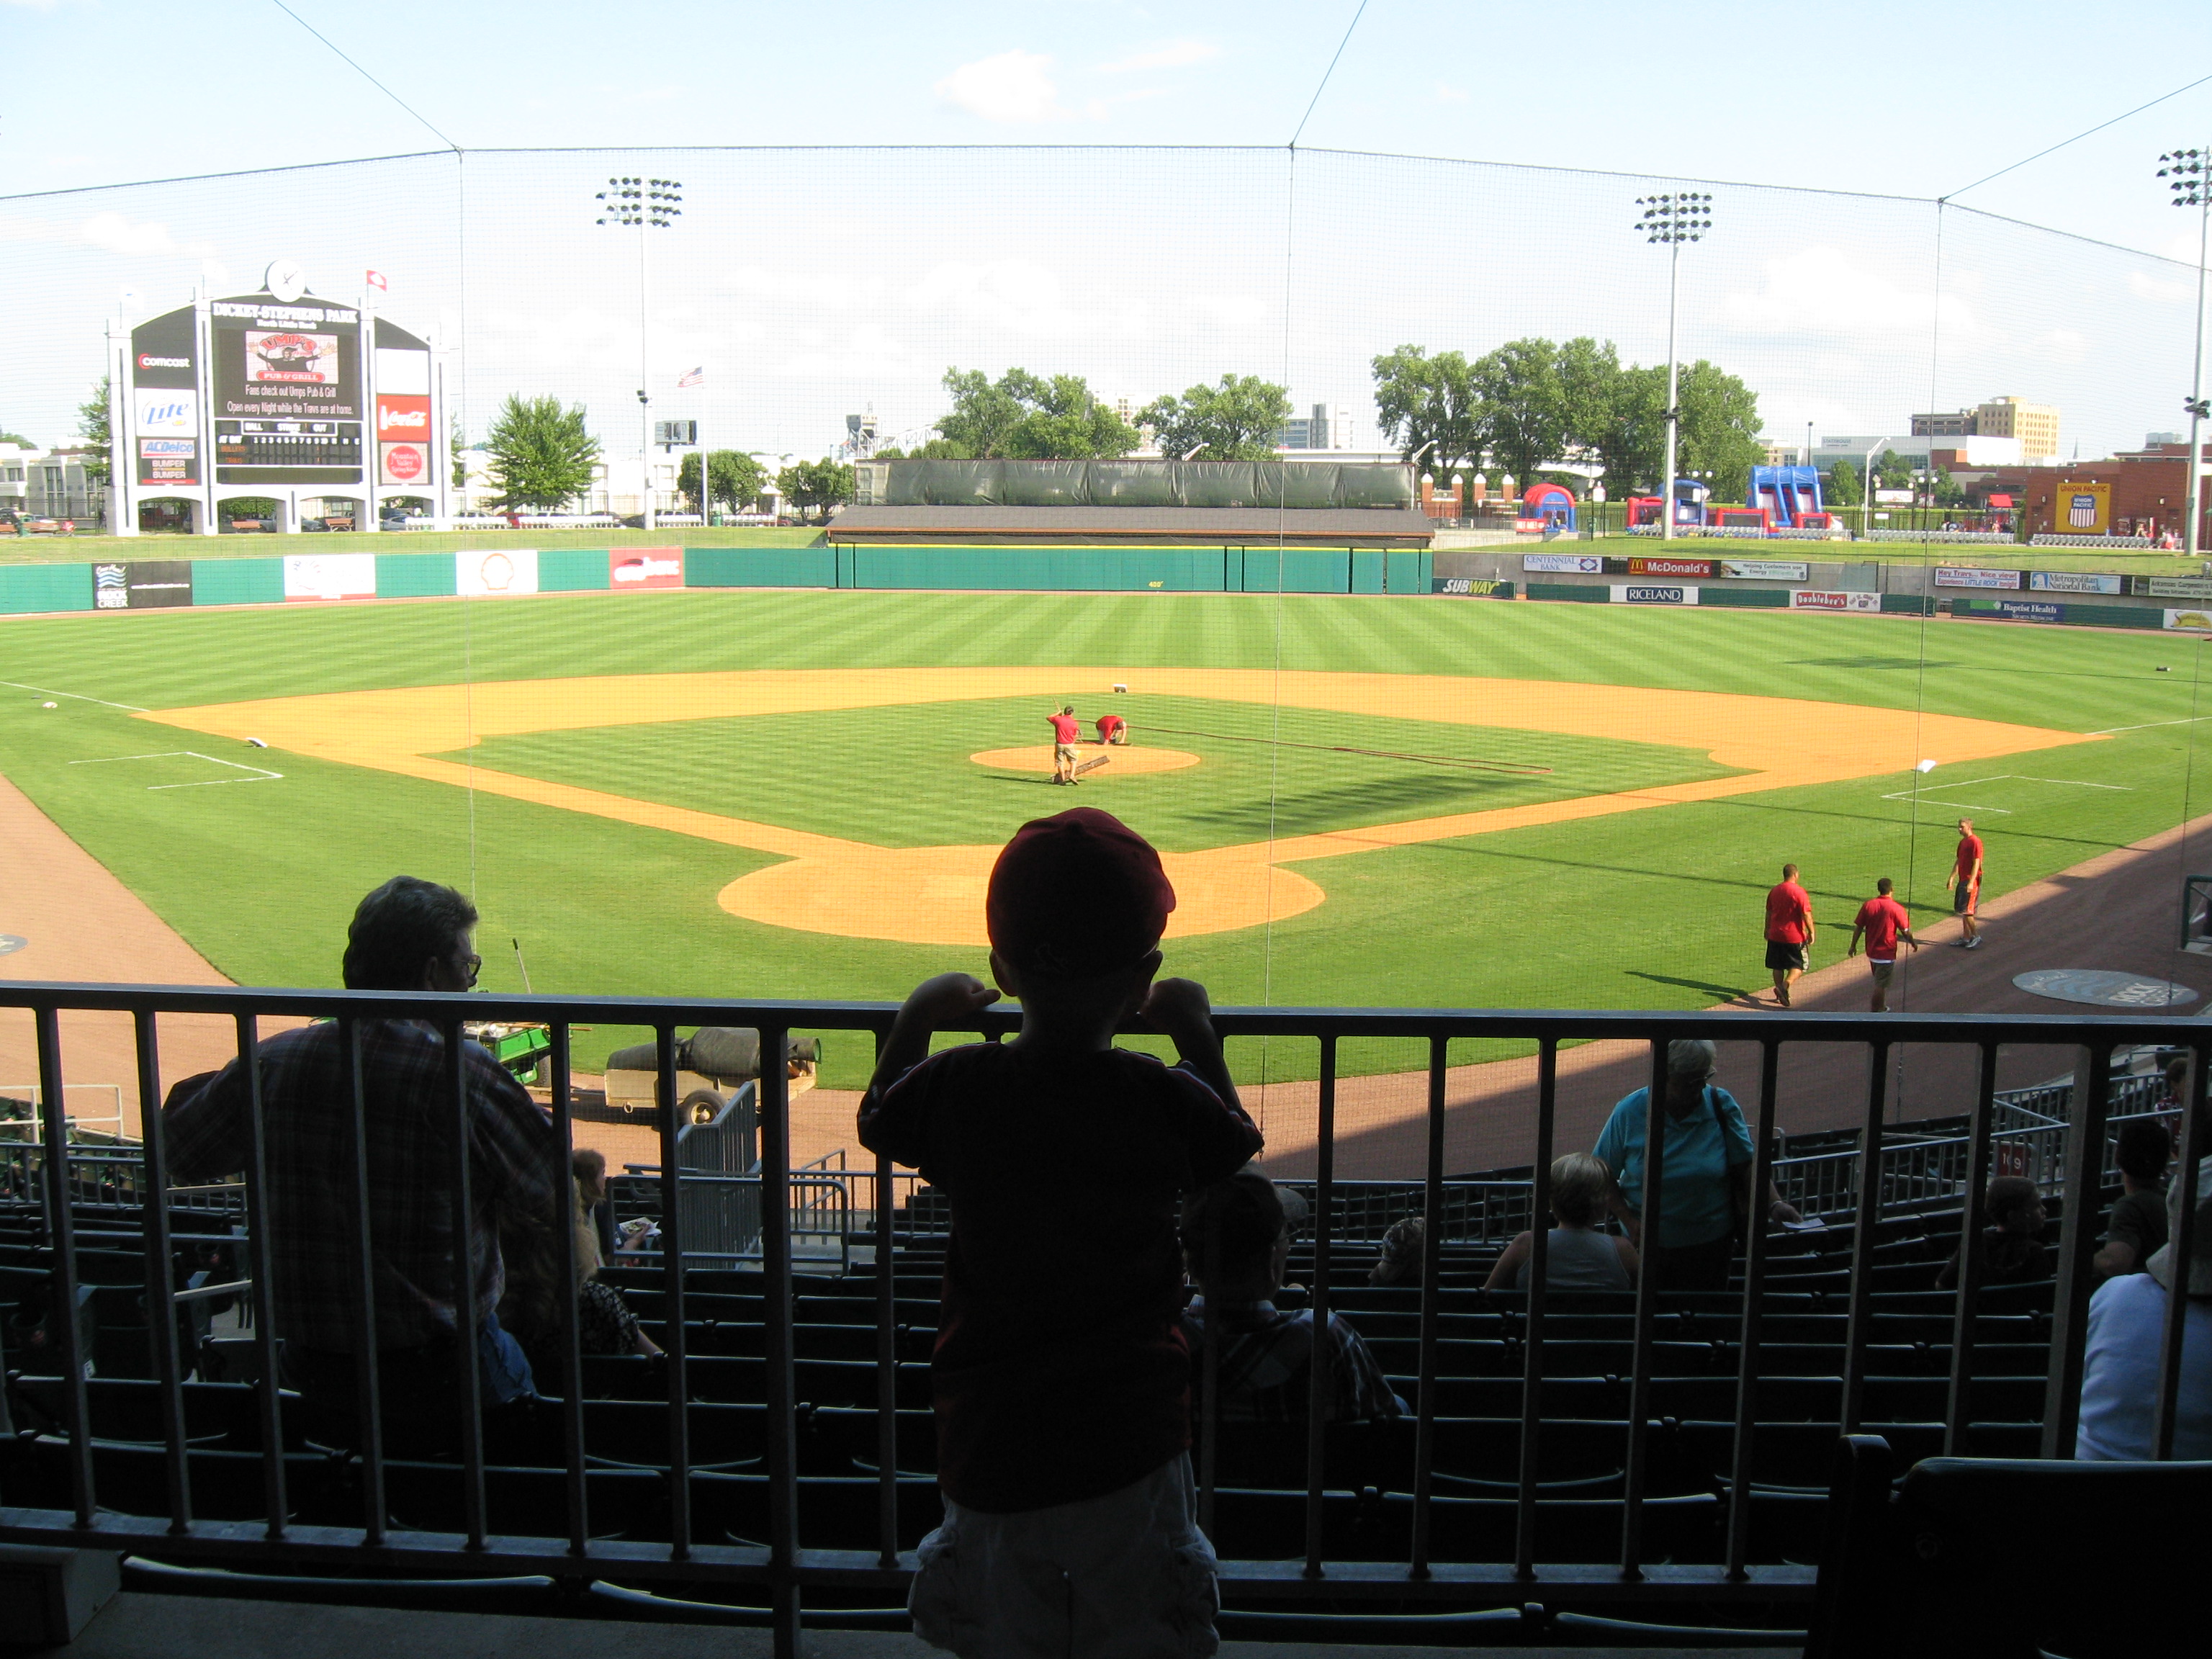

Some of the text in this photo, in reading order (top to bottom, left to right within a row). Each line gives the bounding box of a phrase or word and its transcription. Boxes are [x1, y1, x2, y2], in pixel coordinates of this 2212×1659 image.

[213, 303, 358, 323] DICKEY-STEPHENS PARK
[140, 356, 190, 368] comcast
[246, 385, 336, 399] Fans check out Umps Pub & Grill
[227, 400, 243, 414] Open
[244, 403, 260, 415] every
[261, 402, 276, 415] Night
[277, 403, 292, 413] while
[292, 403, 302, 413] the
[303, 403, 318, 414] Travs
[320, 405, 329, 414] are
[330, 405, 336, 414] at
[147, 403, 189, 425] Lite
[245, 423, 264, 431] BALL
[391, 452, 418, 461] Mountain
[1527, 555, 1575, 565] CENTENNIAL
[1647, 562, 1709, 574] McDonald's
[2049, 574, 2098, 583] Metropolitan
[1442, 580, 1500, 595] SUBWAY
[2049, 582, 2101, 591] National Bank
[97, 590, 127, 600] ROCK
[1629, 588, 1681, 602] RICELAND
[98, 599, 128, 608] CREEK
[2003, 603, 2056, 613] Baptist Health
